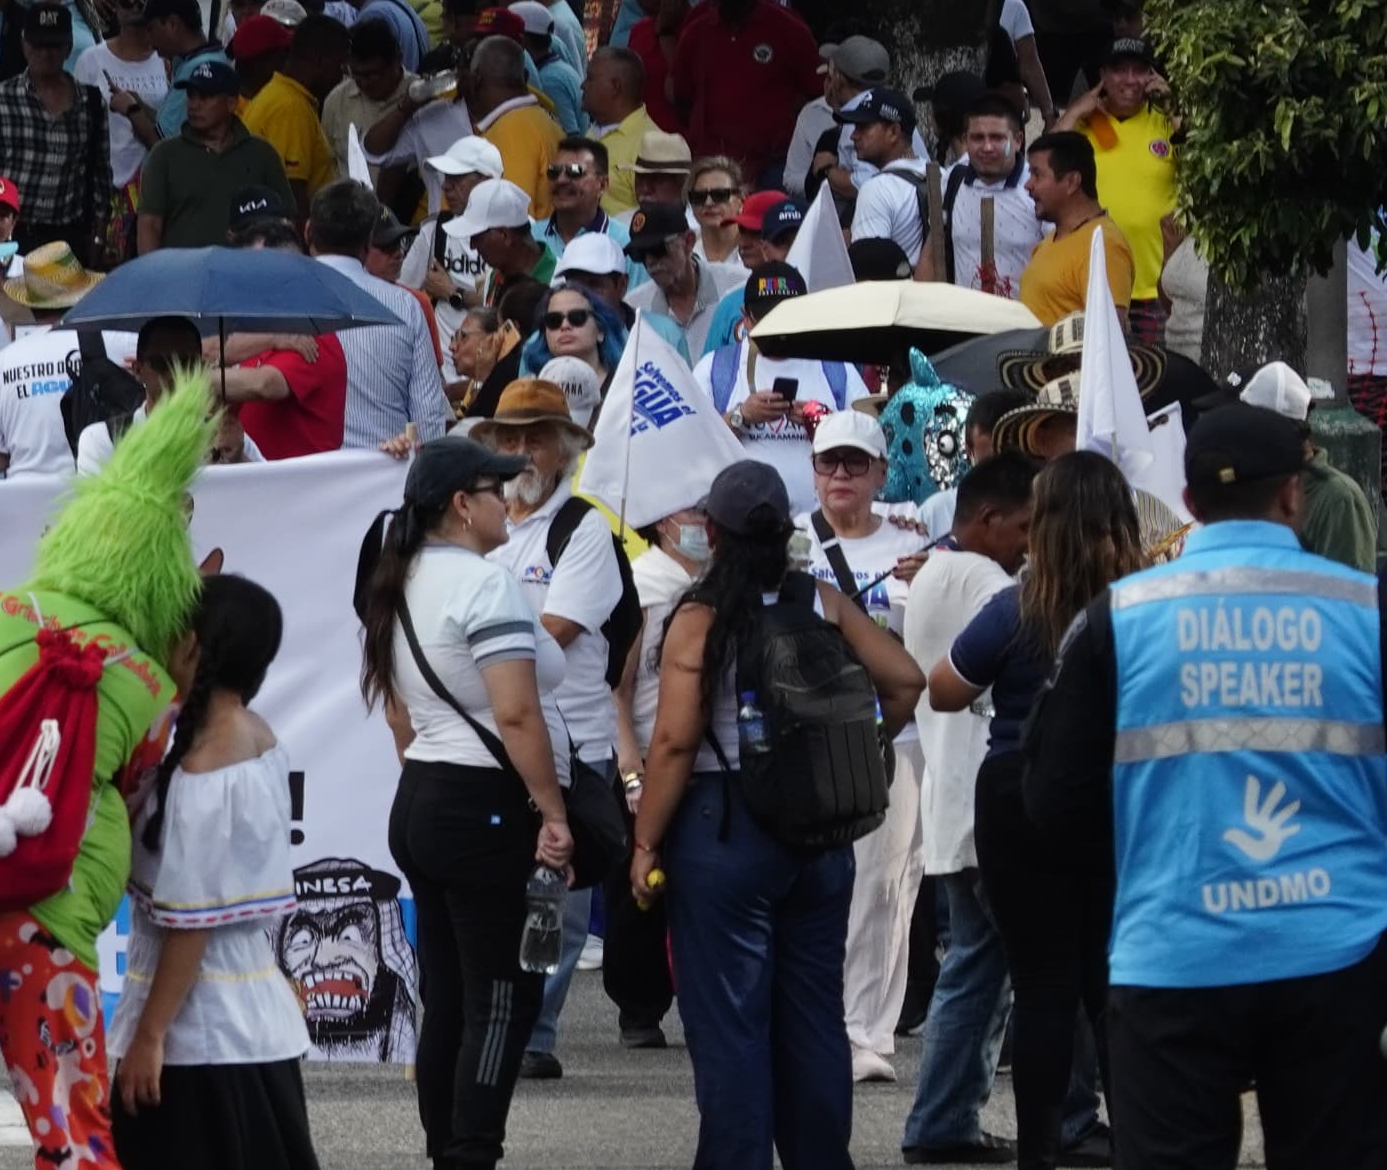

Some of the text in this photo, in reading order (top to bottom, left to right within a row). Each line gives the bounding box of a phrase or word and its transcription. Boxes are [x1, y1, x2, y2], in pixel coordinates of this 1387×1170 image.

[2, 360, 56, 384] NUESTRO
[640, 361, 684, 403] Salvemos
[17, 380, 74, 400] EL AGU
[748, 432, 809, 443] BUCARAMANG
[1178, 597, 1323, 653] DIÁLOGO
[1180, 661, 1325, 708] SPEAKER
[295, 875, 372, 898] INESA
[1201, 867, 1332, 916] UNDMO
